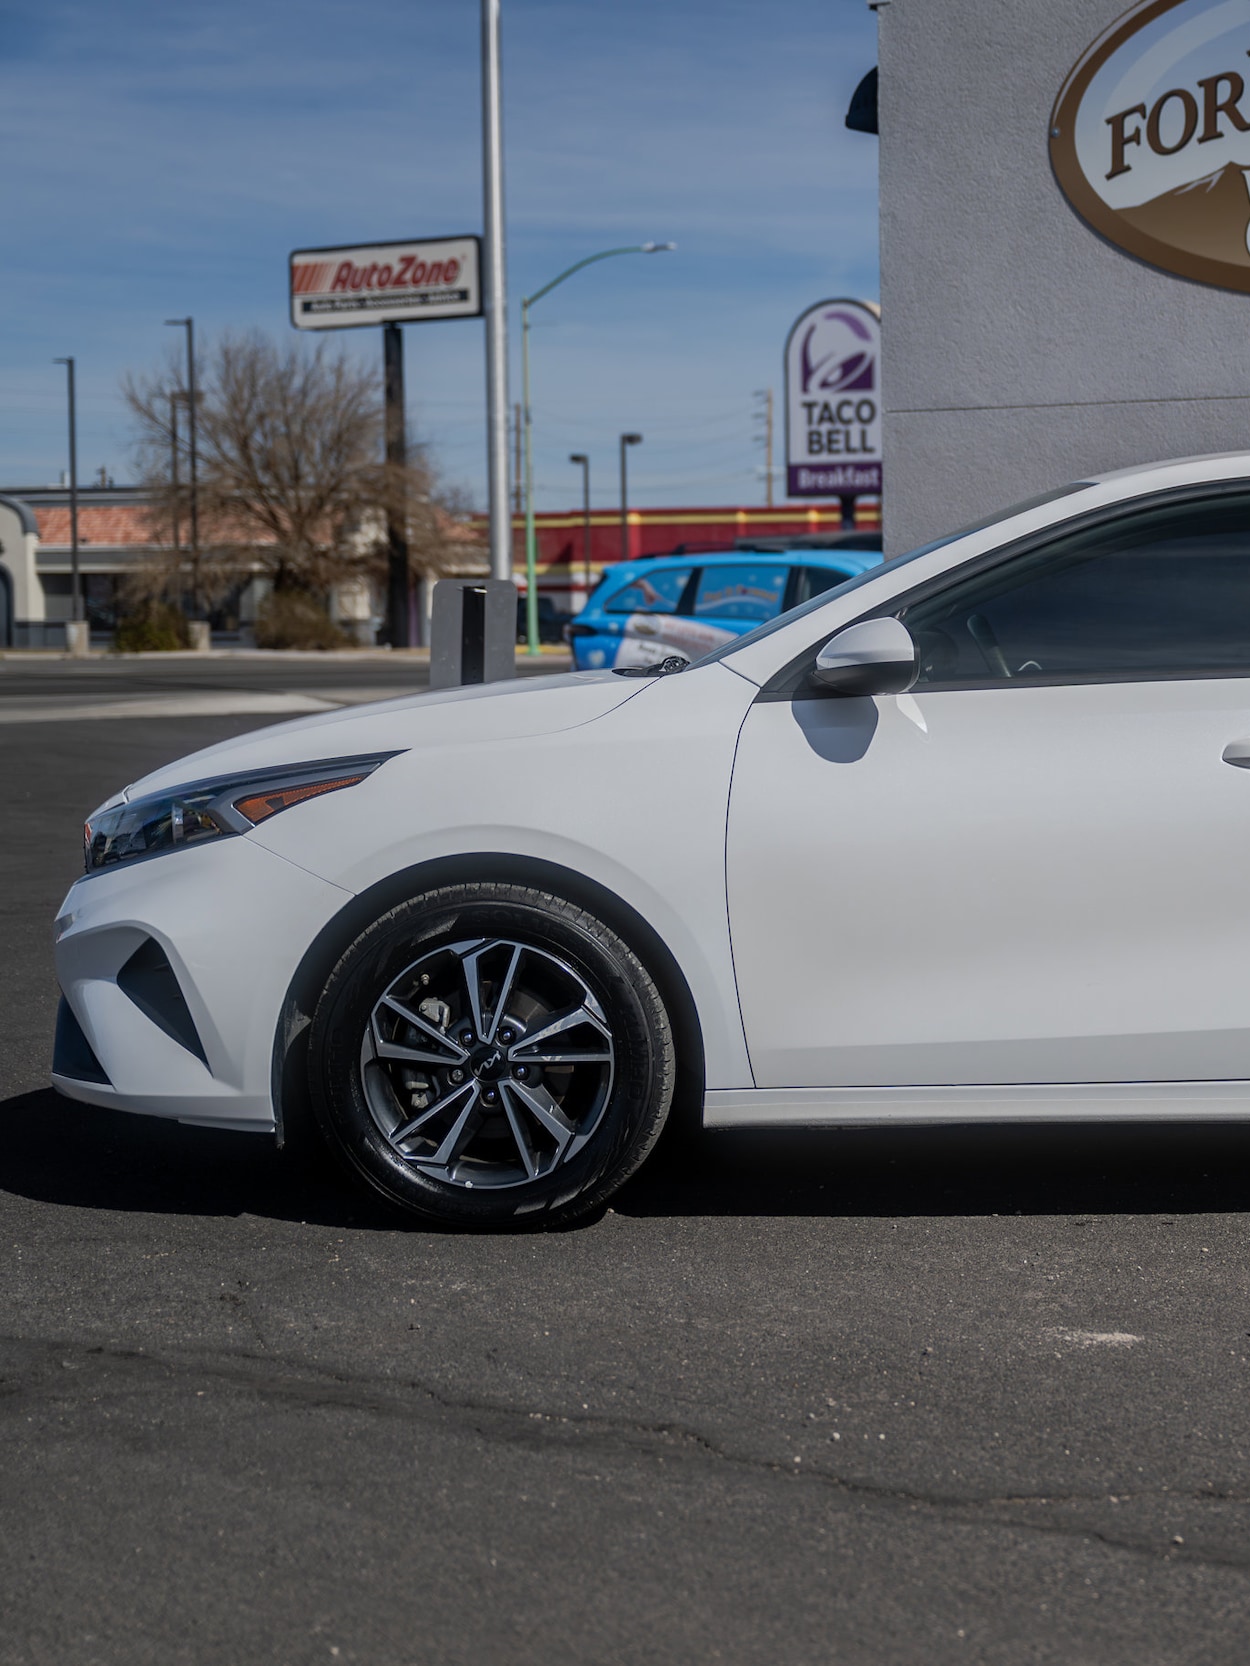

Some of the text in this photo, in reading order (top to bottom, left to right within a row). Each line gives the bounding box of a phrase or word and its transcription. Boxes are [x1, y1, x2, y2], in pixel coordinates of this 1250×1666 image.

[331, 254, 461, 293] AutoZone
[802, 399, 877, 427] TACO
[807, 428, 876, 455] BELL
[798, 466, 880, 490] Breakfast
